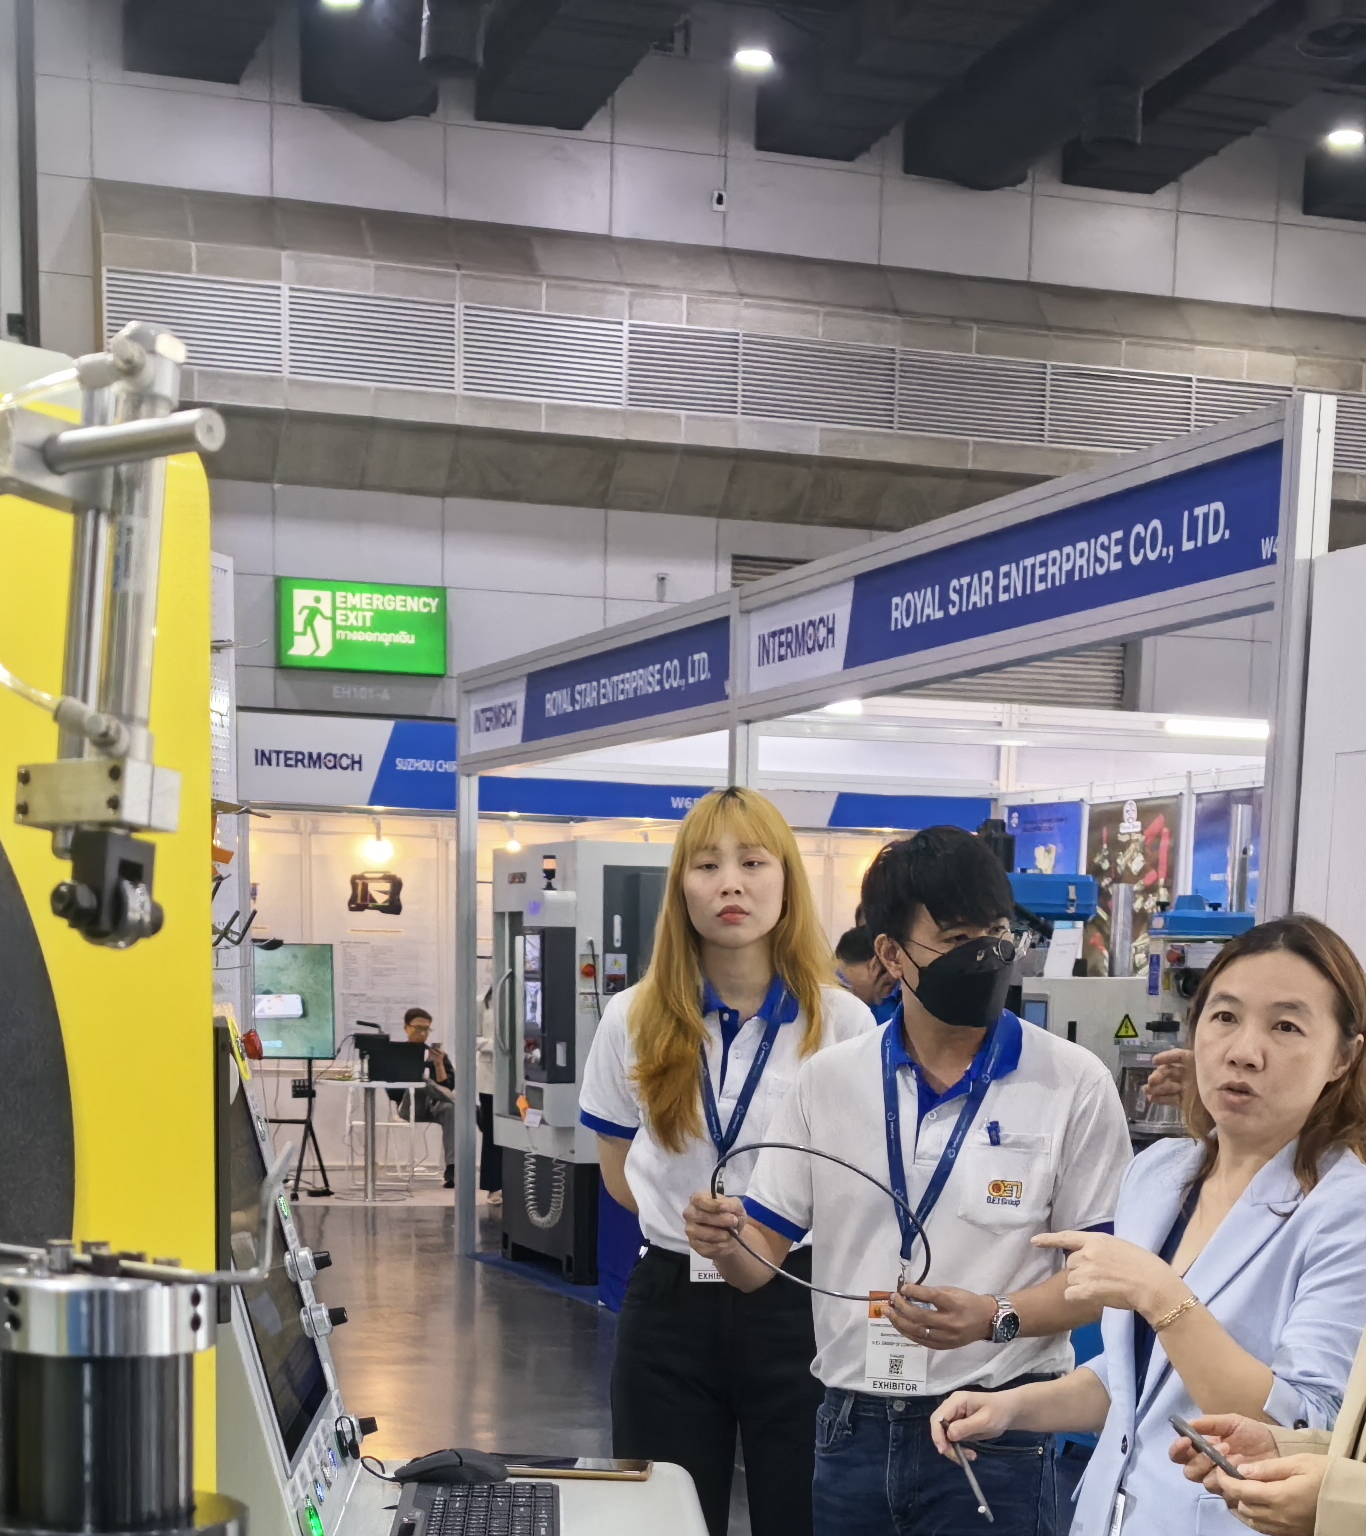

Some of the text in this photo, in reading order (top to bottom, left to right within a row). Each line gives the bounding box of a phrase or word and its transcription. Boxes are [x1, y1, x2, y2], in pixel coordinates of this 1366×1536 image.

[891, 584, 944, 631] ROYAL
[948, 569, 993, 616] STAR
[998, 529, 1124, 603] ENTERPRISE
[1129, 518, 1174, 564] CO.,
[1181, 501, 1230, 552] LTD.
[335, 591, 440, 613] EMERGENCY
[335, 609, 374, 627] EXIT
[545, 689, 573, 718] ROYAL
[574, 680, 598, 711] STAR
[599, 663, 662, 705] ENTERPRISE
[687, 651, 711, 684] LTD.
[395, 757, 436, 772] SUZHOU
[872, 1380, 918, 1392] EXHIBITOR
